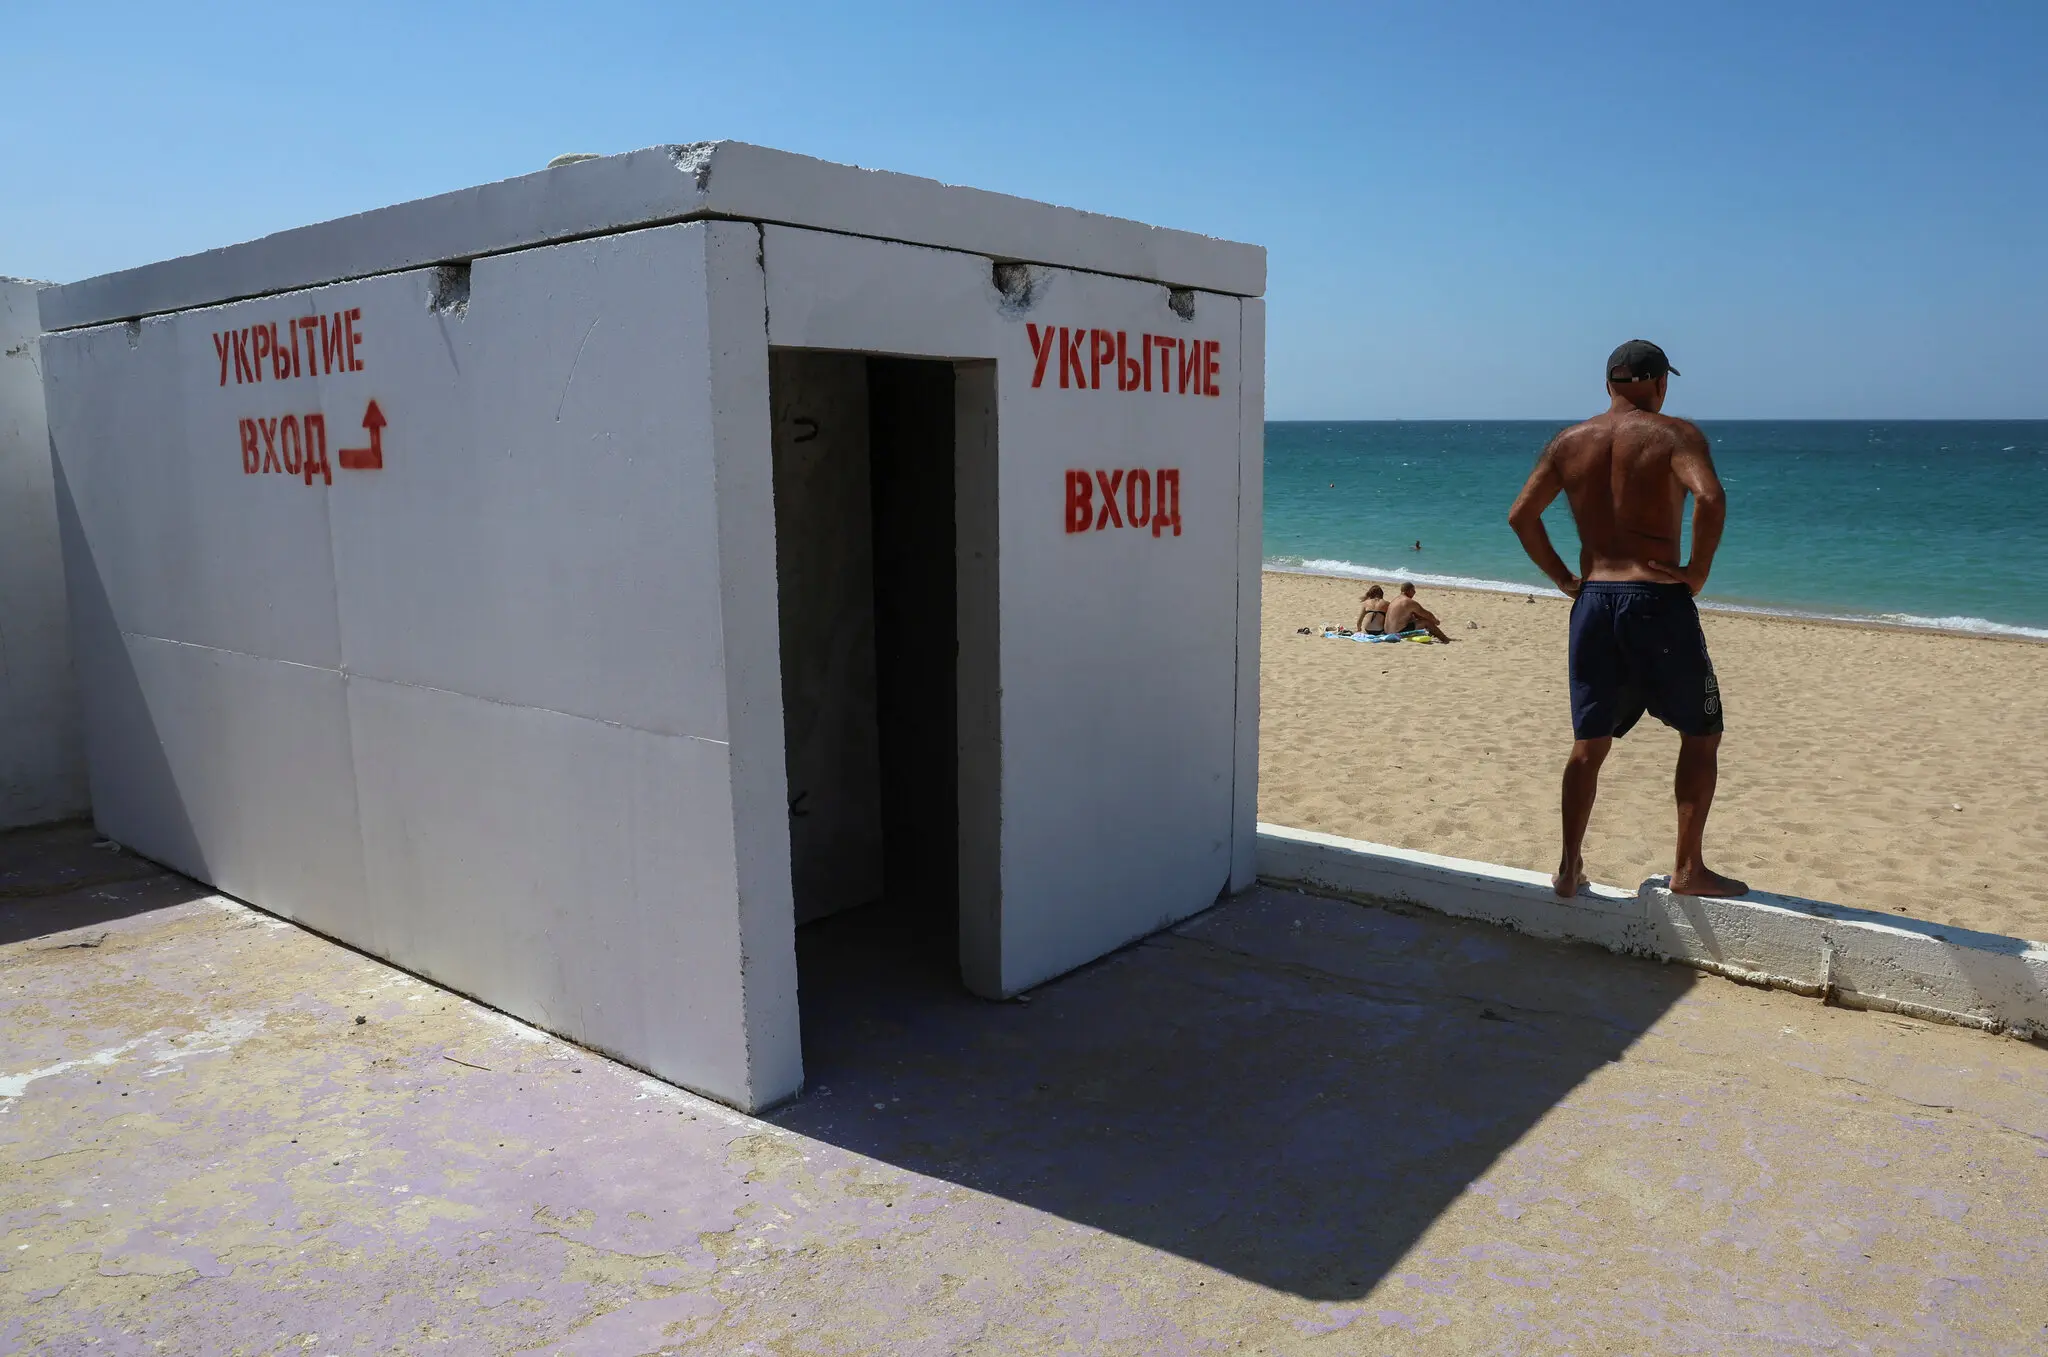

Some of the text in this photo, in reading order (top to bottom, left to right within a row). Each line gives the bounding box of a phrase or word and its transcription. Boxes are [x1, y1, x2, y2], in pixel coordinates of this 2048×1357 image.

[212, 308, 364, 386] УКРЫТИЕ
[1026, 323, 1220, 396] УКРЫТИЕ
[239, 414, 332, 486] ВХОД
[1065, 468, 1181, 538] ВХОД
